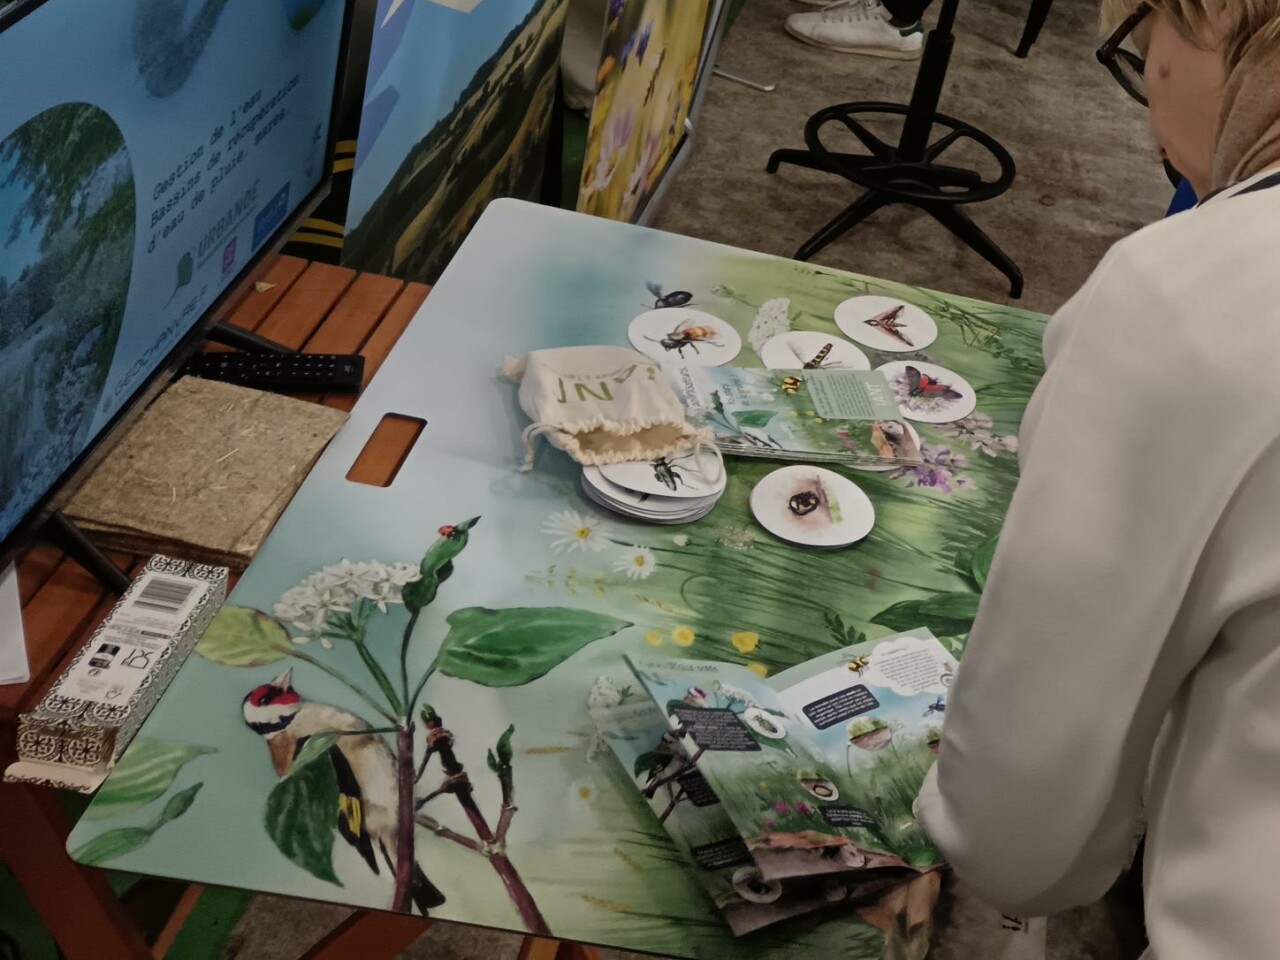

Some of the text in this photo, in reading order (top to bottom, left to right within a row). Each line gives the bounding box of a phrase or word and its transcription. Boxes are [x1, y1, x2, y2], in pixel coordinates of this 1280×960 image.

[154, 89, 262, 200] Gestion de l'eau
[148, 210, 185, 254] d'eau
[190, 189, 205, 210] de
[151, 170, 201, 229] Bassins
[206, 151, 222, 171] de
